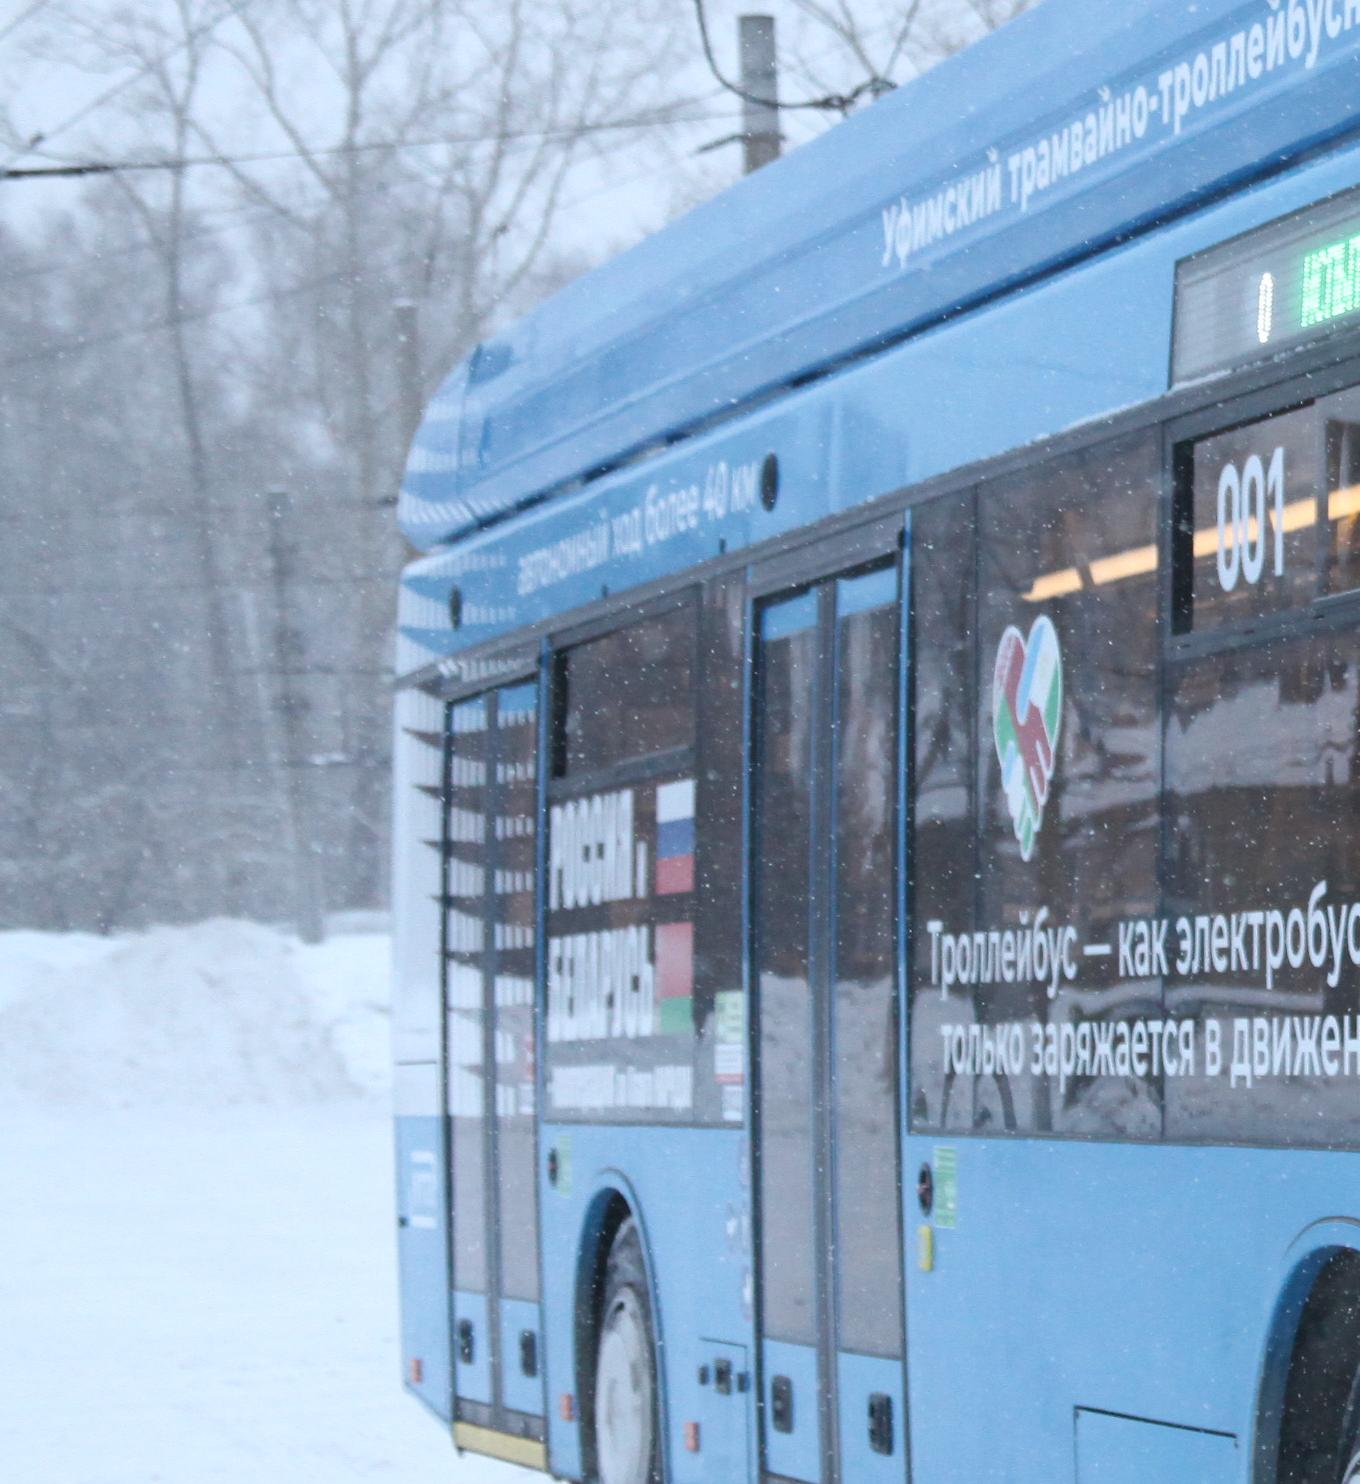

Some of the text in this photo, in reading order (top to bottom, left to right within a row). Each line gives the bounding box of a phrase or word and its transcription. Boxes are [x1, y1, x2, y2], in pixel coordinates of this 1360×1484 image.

[881, 146, 999, 268] Уфимский
[644, 483, 699, 544] более
[703, 460, 730, 520] 40
[1216, 446, 1287, 592] 001
[926, 904, 1078, 998] Троллейбус
[1118, 918, 1170, 978] как
[940, 1020, 1025, 1078] только
[1031, 1016, 1196, 1094] заряжается
[1205, 1017, 1222, 1072] в
